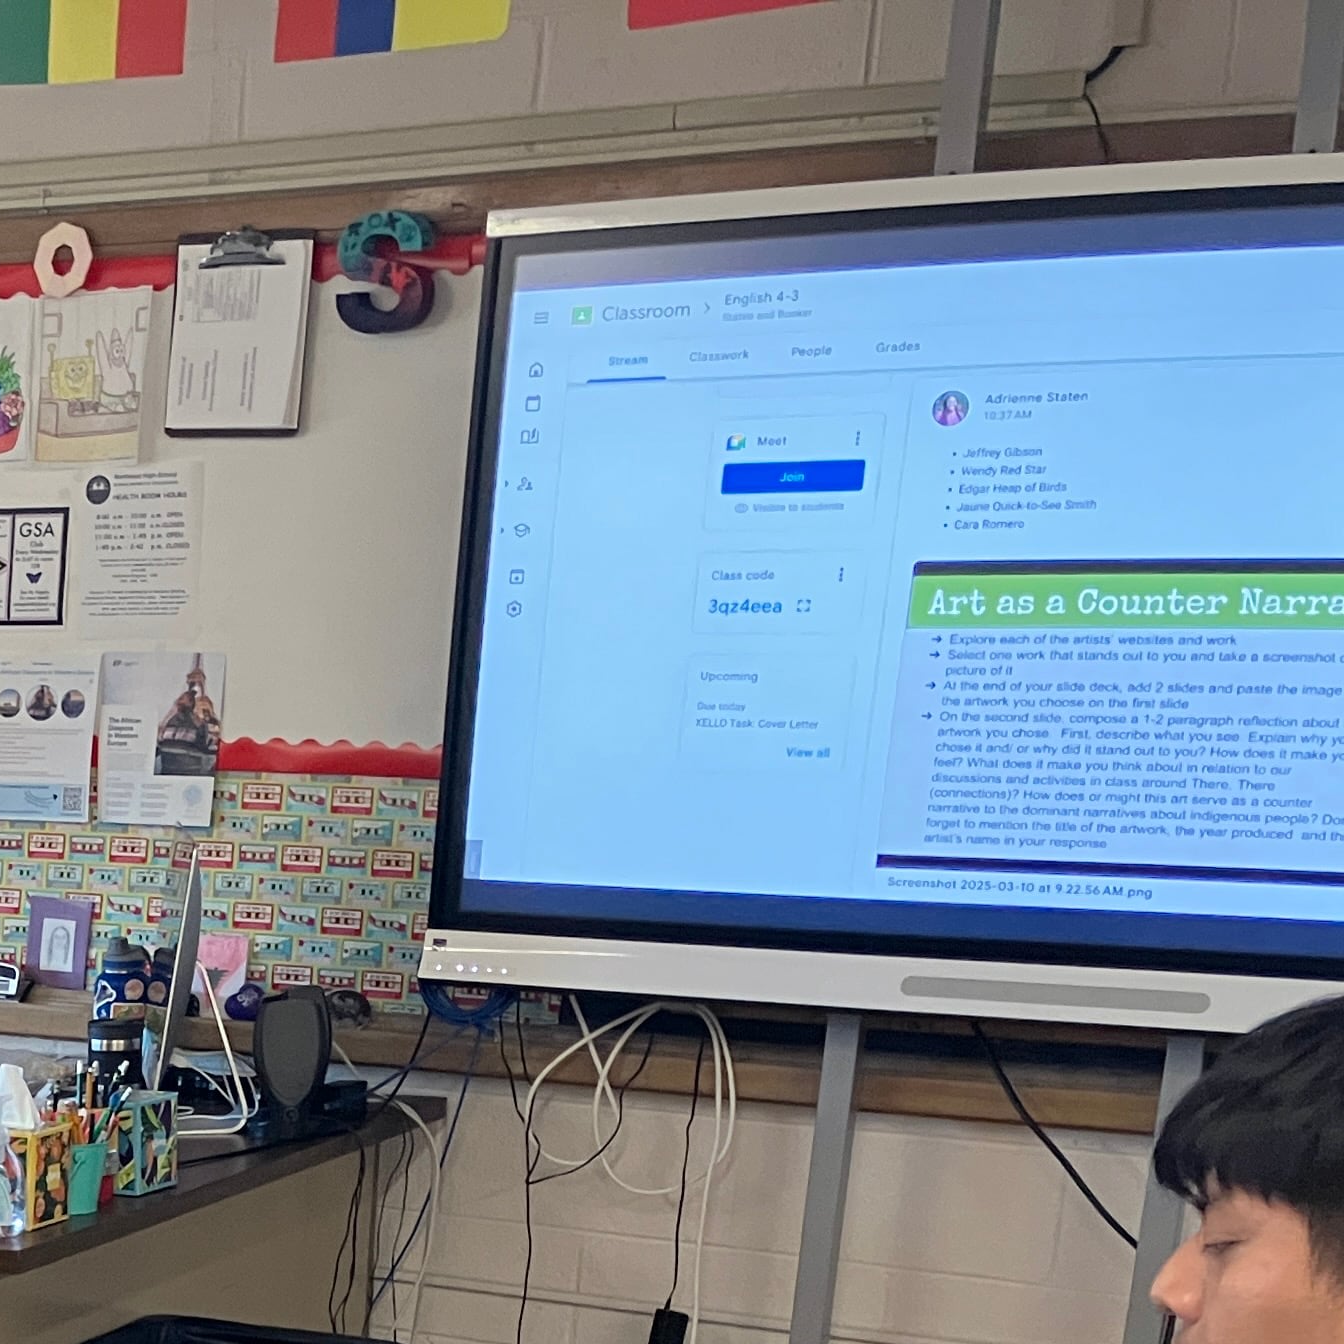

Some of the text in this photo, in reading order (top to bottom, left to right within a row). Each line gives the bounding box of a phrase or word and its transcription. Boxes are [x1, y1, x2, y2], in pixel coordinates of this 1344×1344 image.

[602, 289, 799, 322] Classroom English 4-3
[608, 341, 920, 366] Stream Classwork People Grades
[985, 392, 1088, 404] Adrienne Staten
[757, 436, 786, 446] Meet
[963, 447, 1042, 460] Jeffrey Gibson
[961, 465, 1047, 477] Wendy Red Star
[779, 472, 805, 483] Join
[958, 482, 1067, 495] Edgar Heap of Birds
[956, 502, 990, 512] Jaune
[1065, 500, 1097, 510] Smith
[19, 521, 55, 538] GSA
[954, 520, 1025, 530] Cara Romero
[712, 570, 775, 581] Class code
[708, 599, 782, 616] 3qz4eea
[927, 588, 986, 616] Art
[996, 595, 1034, 615] as
[1045, 594, 1065, 615] a
[1077, 587, 1228, 615] Counter
[949, 634, 996, 646] Explore
[999, 634, 1030, 644] each
[1033, 634, 1047, 644] of
[1049, 634, 1069, 645] the
[1118, 635, 1174, 646] websites
[1178, 635, 1203, 646] and
[1206, 635, 1237, 646] work
[947, 650, 1336, 663] Select one work that stands out to you and take a screenshot
[945, 665, 1013, 677] picture of it
[700, 671, 759, 684] Upcoming
[943, 680, 1342, 698] At the end of your slide deck, add 2 slides and paste the image
[941, 697, 1189, 709] the artwork you choose on the first slide
[696, 718, 727, 728] XELLO
[758, 720, 786, 729] Cover
[790, 720, 819, 730] Letter
[939, 711, 958, 721] On
[961, 711, 980, 722] the
[984, 712, 1029, 722] second
[1069, 715, 1126, 725] compose
[1131, 716, 1139, 724] a
[1143, 714, 1163, 725] 1-2
[1167, 716, 1234, 727] paragraph
[1238, 715, 1298, 728] reflection
[1302, 717, 1340, 729] about
[786, 747, 830, 758] View all
[887, 877, 957, 889] Screenshot
[1038, 885, 1050, 893] at
